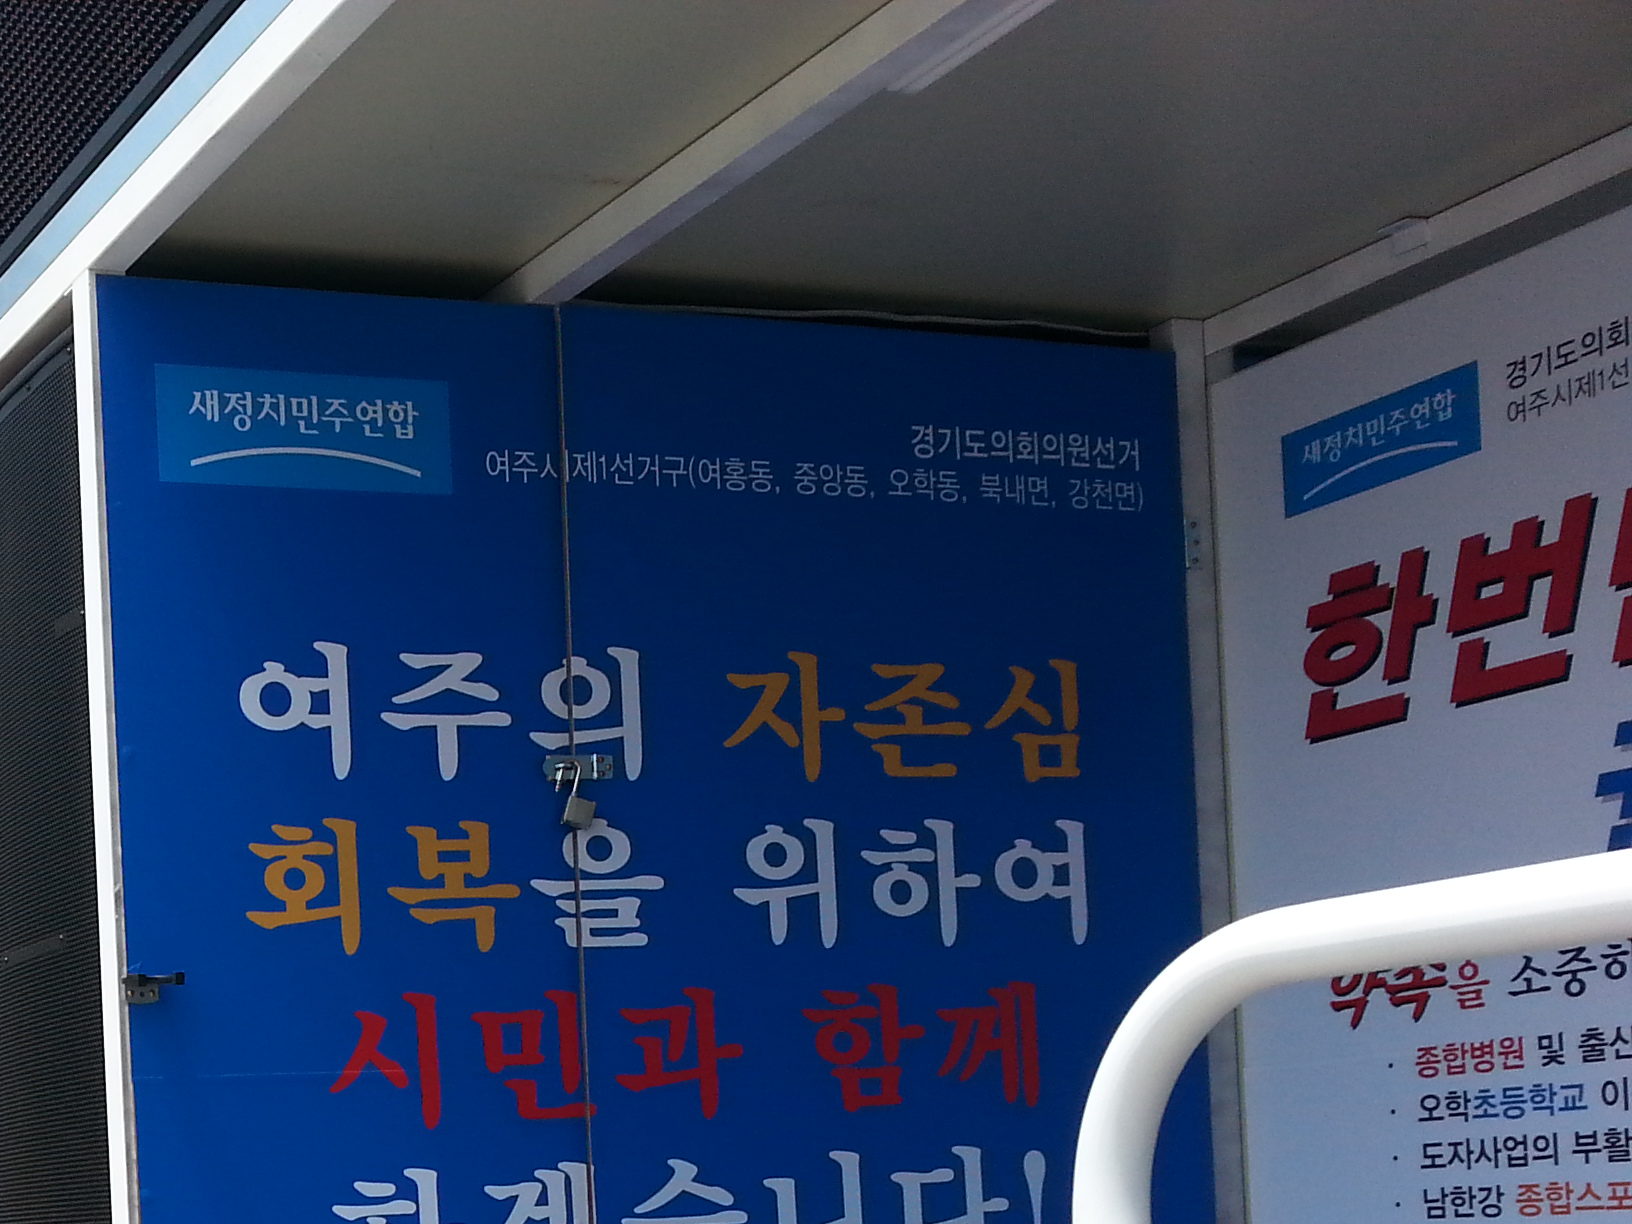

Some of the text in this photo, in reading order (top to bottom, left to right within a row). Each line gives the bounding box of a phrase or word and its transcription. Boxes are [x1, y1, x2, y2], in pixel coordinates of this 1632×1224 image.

[188, 389, 420, 440] 새정치민주연합
[1301, 388, 1457, 465] 새정치민주연합
[911, 424, 1141, 472] 경기도의회의원선거
[793, 462, 876, 499] 중앙동,
[888, 468, 968, 504] 오학동,
[979, 473, 1056, 508] 북내면,
[1068, 478, 1144, 513] 강천면)
[1303, 474, 1632, 744] 한번
[238, 641, 1081, 783] 여주의 자존심
[245, 816, 1090, 957] 회복을 위하여
[329, 980, 1040, 1130] 시민과 함께
[1415, 1036, 1526, 1079] 종합병원
[1537, 1032, 1565, 1067] 및
[1418, 1082, 1588, 1123] 오학초등학교
[1420, 1132, 1559, 1171] 도자사업의
[1423, 1181, 1632, 1219] 남한강 종합스포
